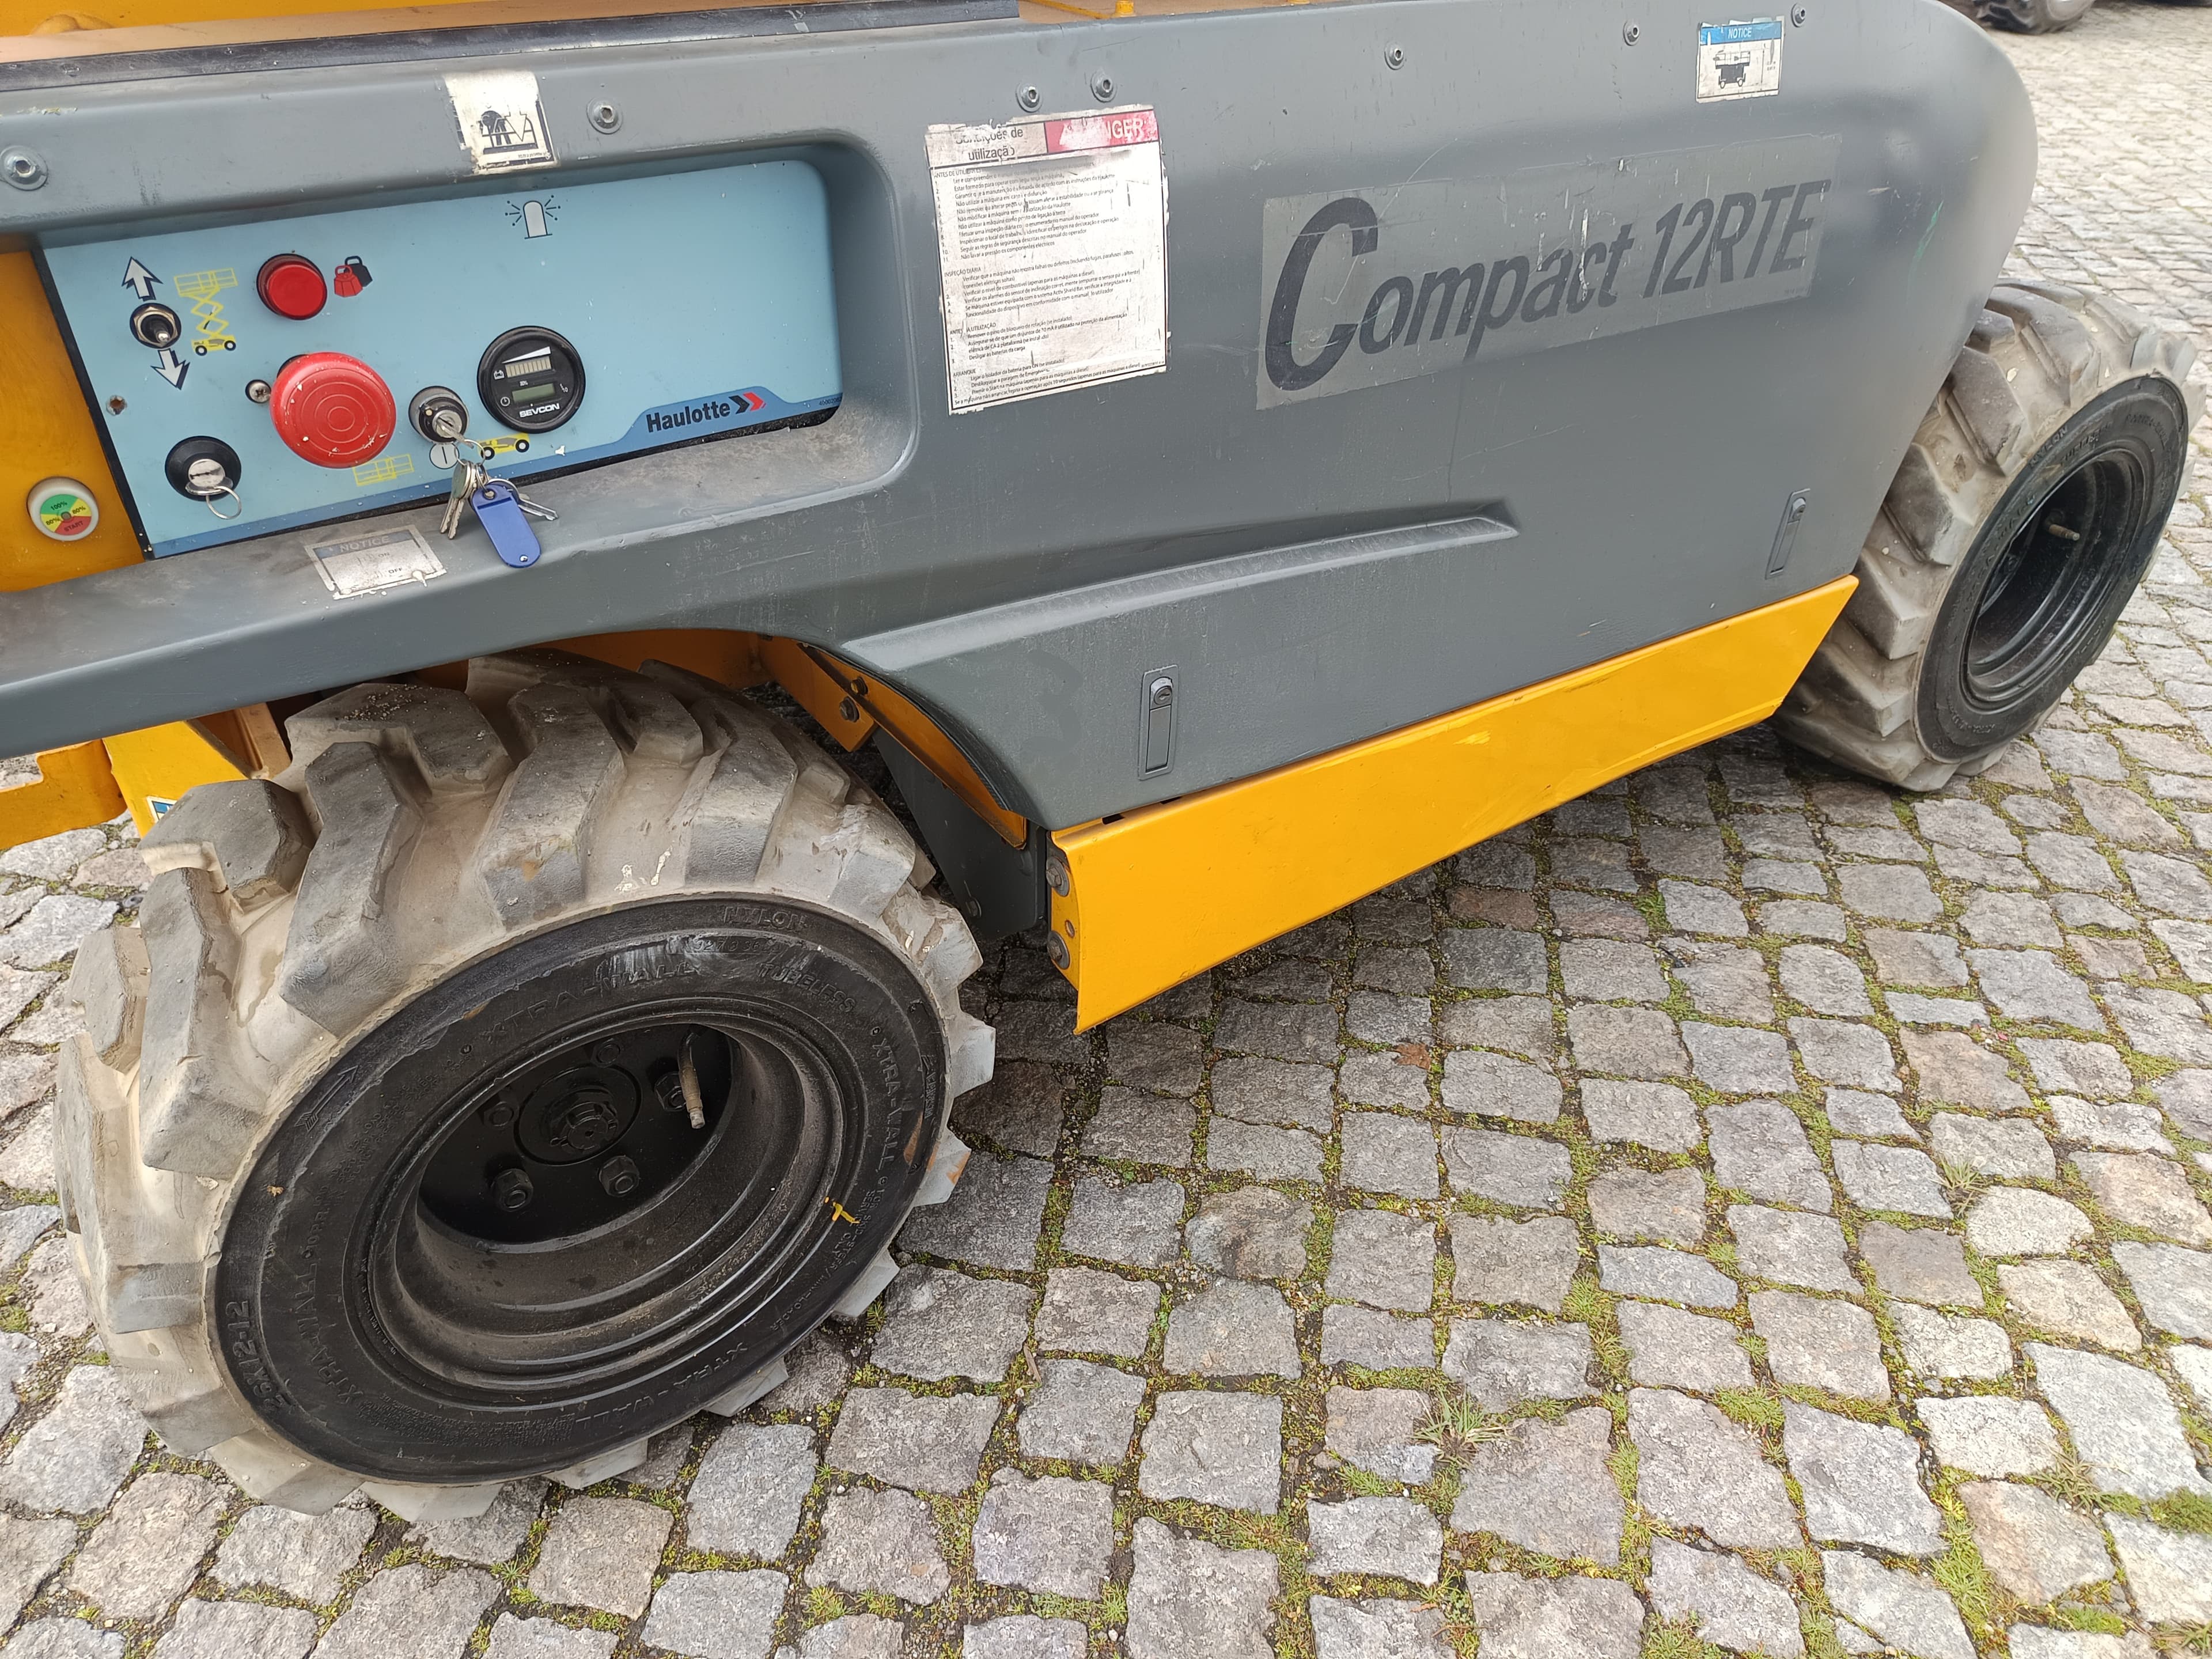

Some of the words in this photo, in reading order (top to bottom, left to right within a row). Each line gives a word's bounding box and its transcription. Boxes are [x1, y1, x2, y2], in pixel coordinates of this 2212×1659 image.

[1728, 27, 1752, 40] NOTICE
[1011, 127, 1024, 138] de
[960, 245, 974, 253] Seguir
[999, 239, 1021, 247] segurança
[1068, 228, 1086, 237] operador
[984, 249, 1001, 257] pressão
[1006, 244, 1035, 254] componentes
[993, 269, 1011, 278] máquina
[1058, 272, 1078, 282] máquinas
[1264, 196, 1635, 390] Compact
[1643, 179, 1832, 298] 12RTE
[971, 302, 990, 311] máquina
[519, 403, 560, 418] SEVCON
[646, 401, 731, 433] Haulotte
[50, 501, 68, 511] 100%
[63, 520, 84, 532] START
[339, 535, 391, 553] NOTICE
[751, 962, 859, 1016] TUBELESS
[870, 1036, 901, 1170] XTRA-WALL
[224, 1295, 289, 1414] 26X12-12
